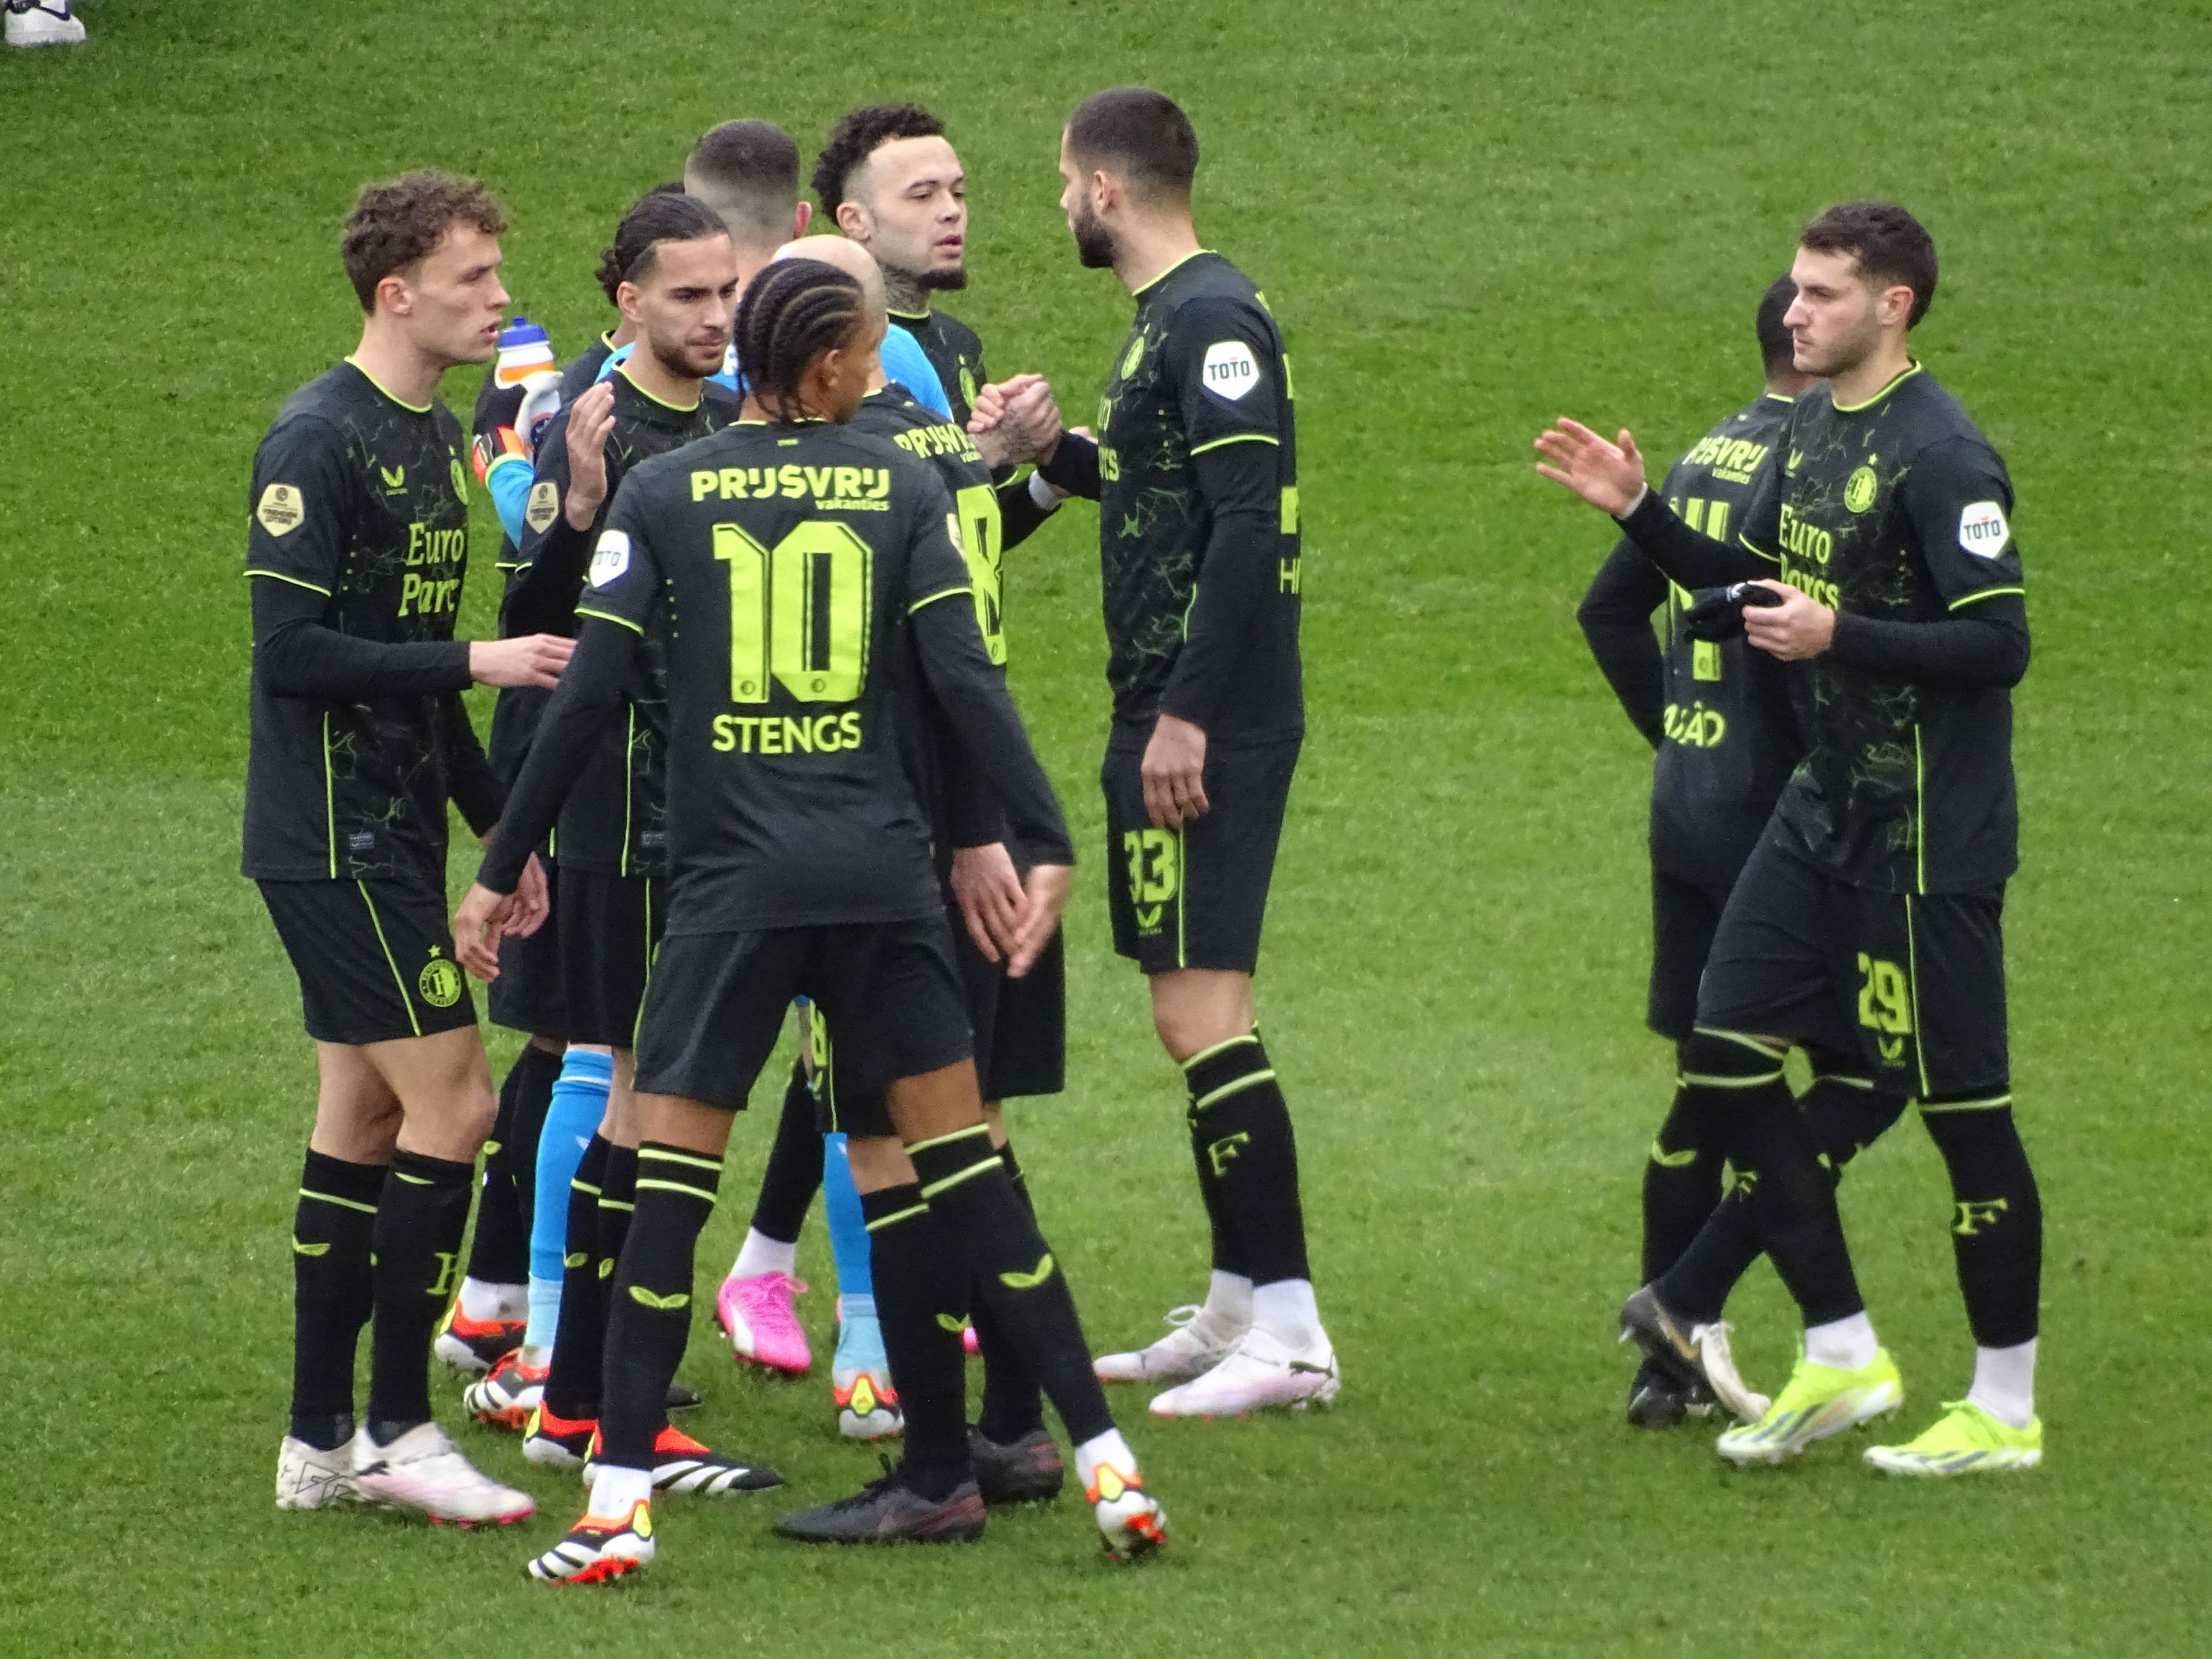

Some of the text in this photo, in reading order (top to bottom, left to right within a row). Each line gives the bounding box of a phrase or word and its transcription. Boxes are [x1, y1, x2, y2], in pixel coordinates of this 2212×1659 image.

[1207, 361, 1250, 381] TOTO
[815, 497, 891, 511] vakanties
[406, 522, 465, 566] Euro
[1779, 503, 1831, 565] Euro
[1963, 520, 2001, 541] TOTO
[713, 521, 873, 703] 10
[712, 712, 862, 753] STENGS
[1858, 951, 1912, 1035] 29
[1208, 1131, 1251, 1177] F
[1952, 1198, 2009, 1235] F
